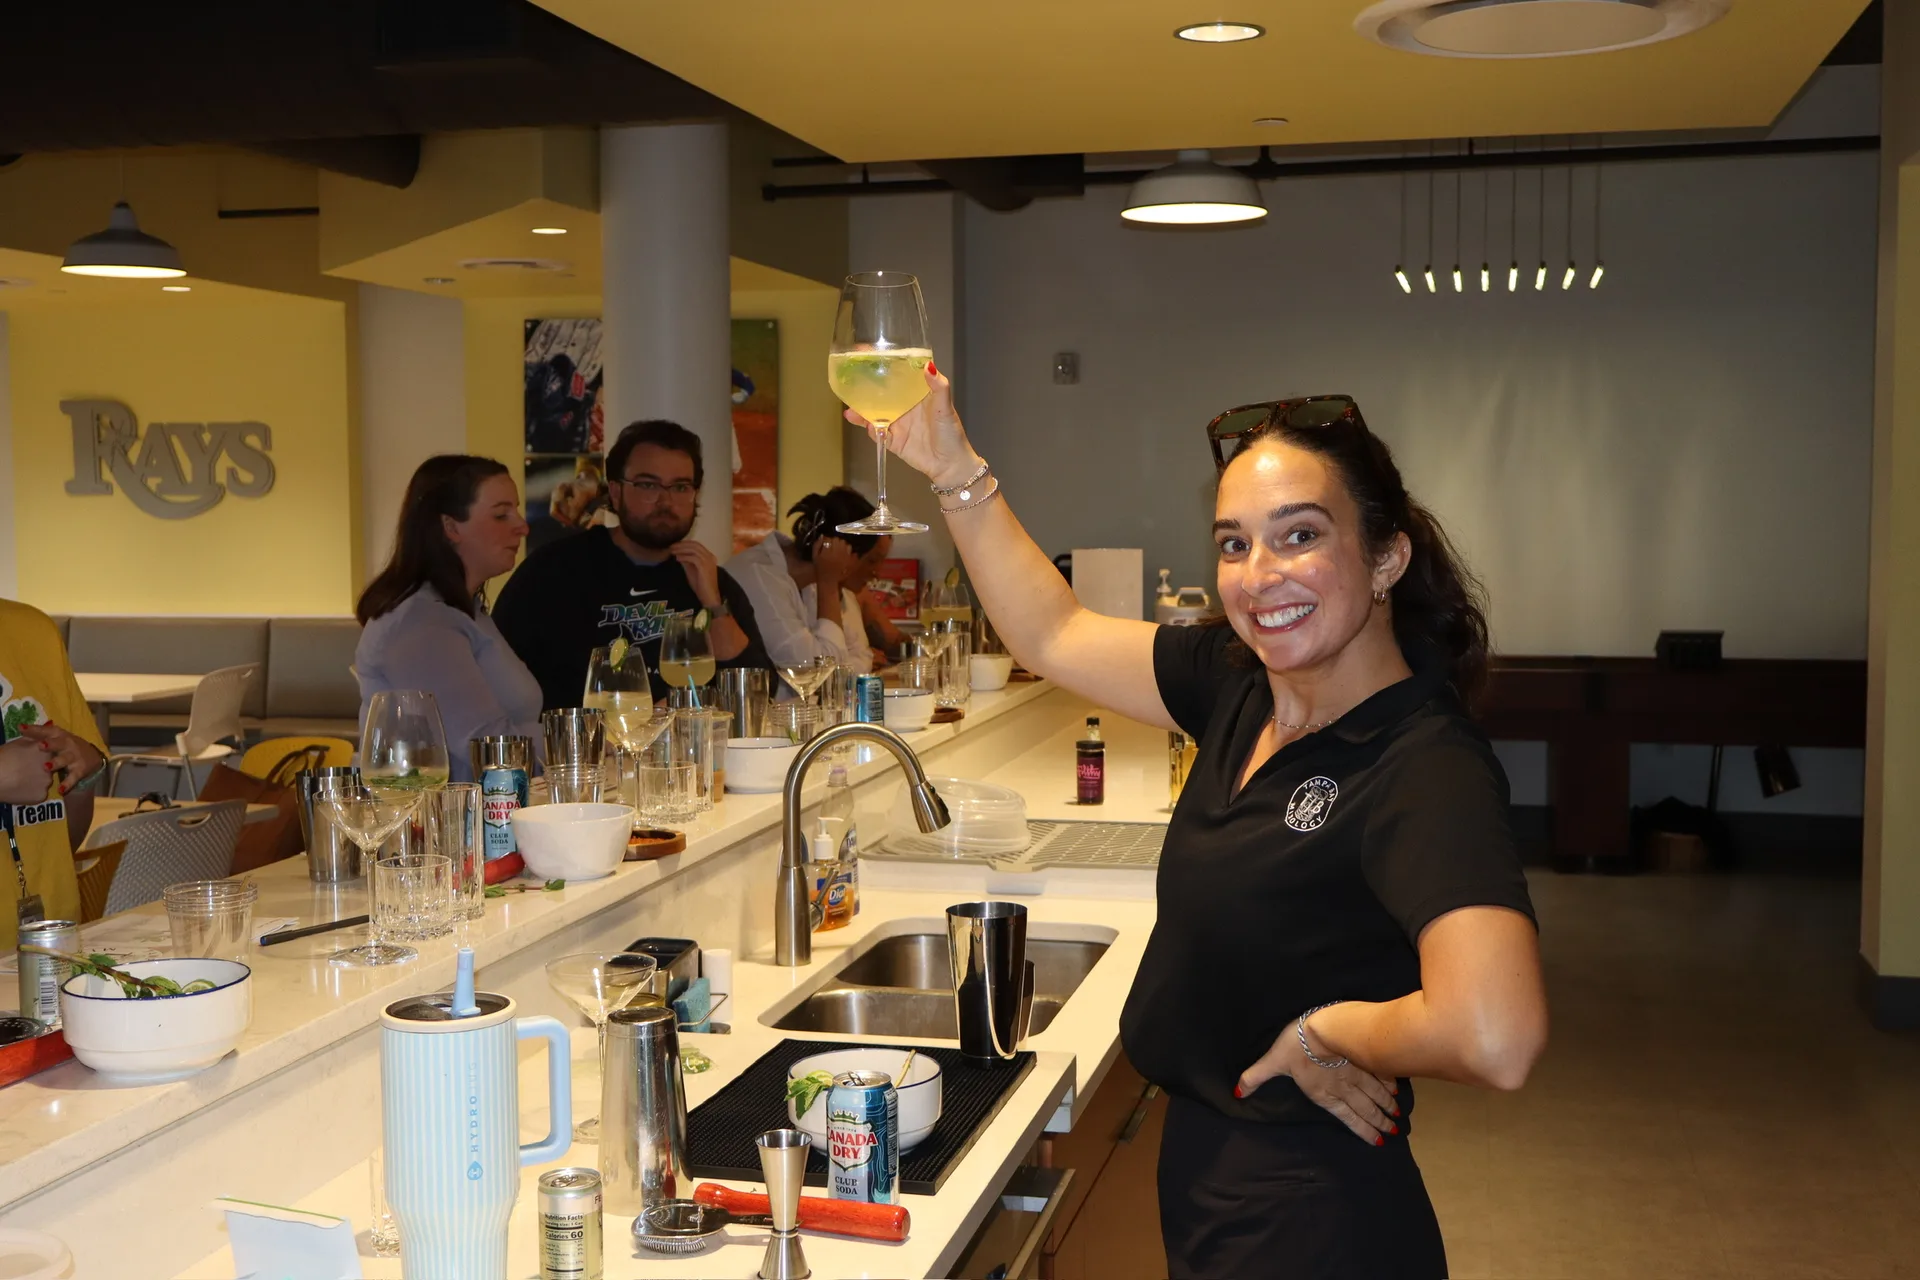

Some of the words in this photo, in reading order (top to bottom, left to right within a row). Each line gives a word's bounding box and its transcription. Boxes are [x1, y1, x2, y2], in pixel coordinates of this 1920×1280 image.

[59, 400, 276, 520] RAYS
[598, 600, 676, 627] DEVIL
[17, 801, 63, 826] Team
[488, 811, 511, 820] DRY
[829, 886, 846, 900] Dial
[833, 1143, 861, 1160] DRY
[835, 1175, 858, 1187] CLUB
[835, 1185, 858, 1196] SODA
[570, 1230, 583, 1239] 60
